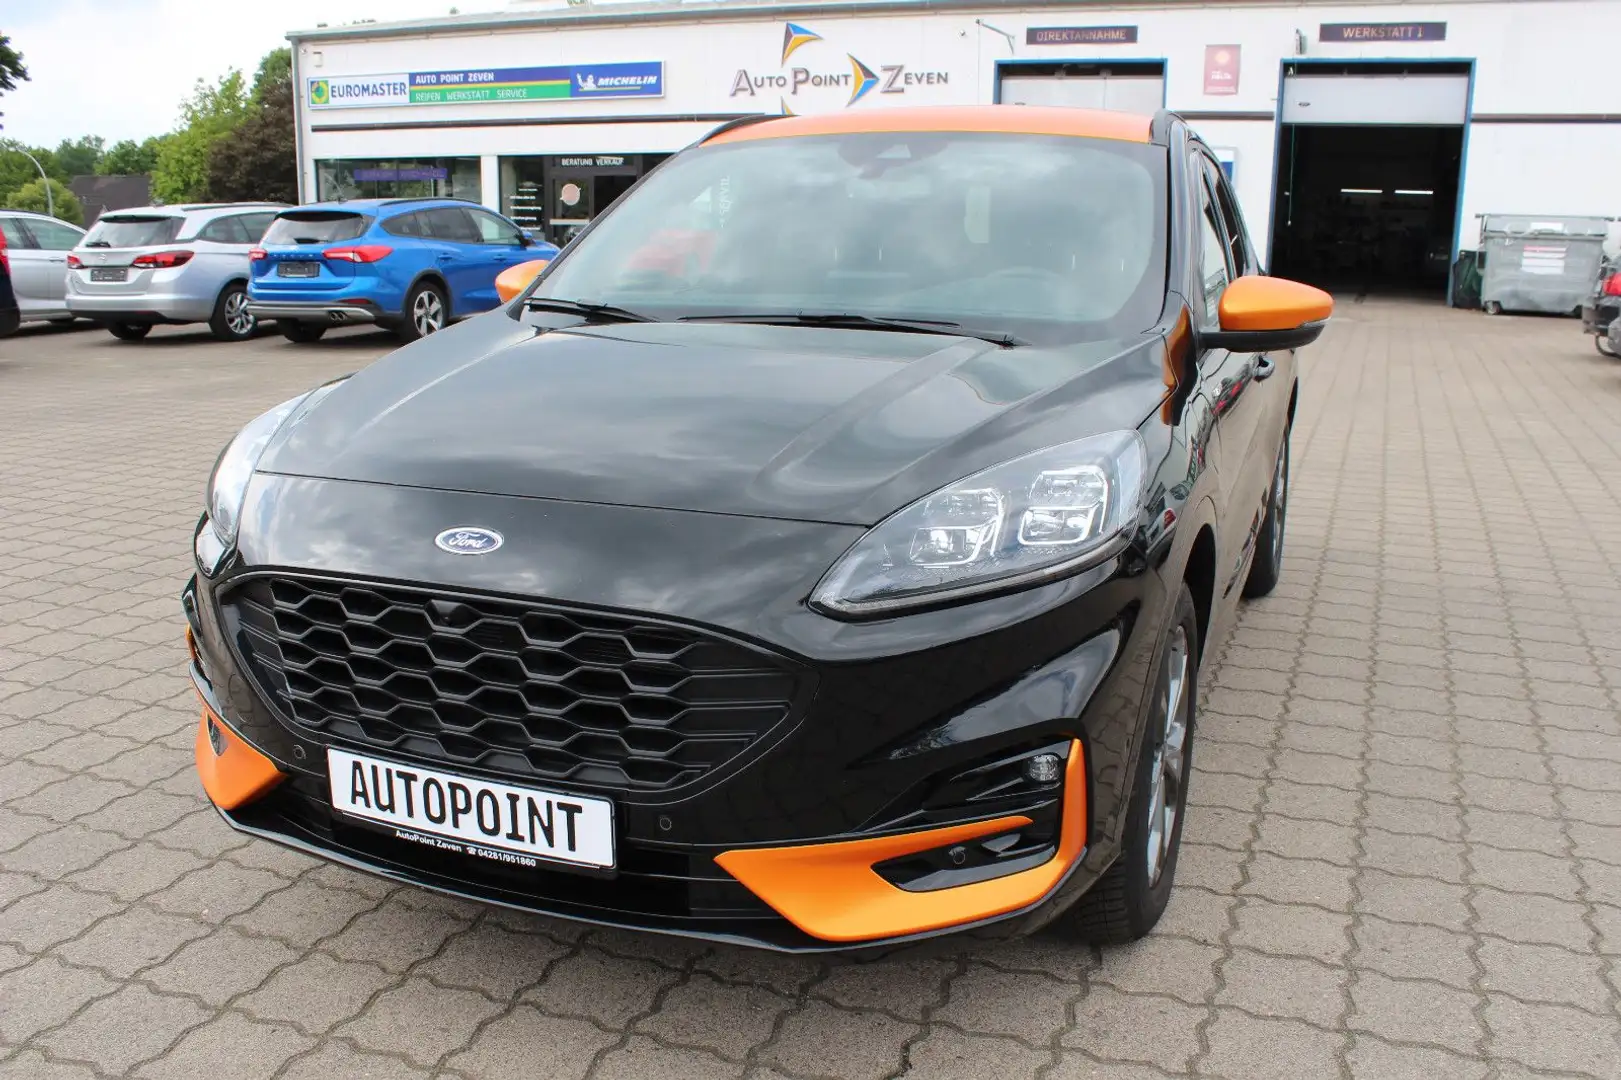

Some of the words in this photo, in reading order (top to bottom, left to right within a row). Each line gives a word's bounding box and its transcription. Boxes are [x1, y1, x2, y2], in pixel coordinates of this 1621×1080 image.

[1036, 29, 1127, 42] DIREKTANNAHME
[1342, 26, 1413, 39] WERKSTATT
[415, 74, 437, 84] AUTO
[440, 73, 465, 83] POINT
[467, 72, 495, 82] ZEVEN
[597, 75, 658, 87] MICHELIN
[331, 81, 407, 99] EUROMASTER
[415, 91, 441, 101] REIFEN
[446, 90, 490, 100] WERKSTATT
[496, 88, 528, 99] SERVICE
[561, 157, 593, 166] BERATUNG
[596, 157, 625, 166] VERKAUF
[350, 759, 583, 852] AUTOPOINT
[395, 829, 436, 847] AutoPoint
[436, 839, 462, 852] Zeven
[477, 849, 537, 867] 04281/951860
